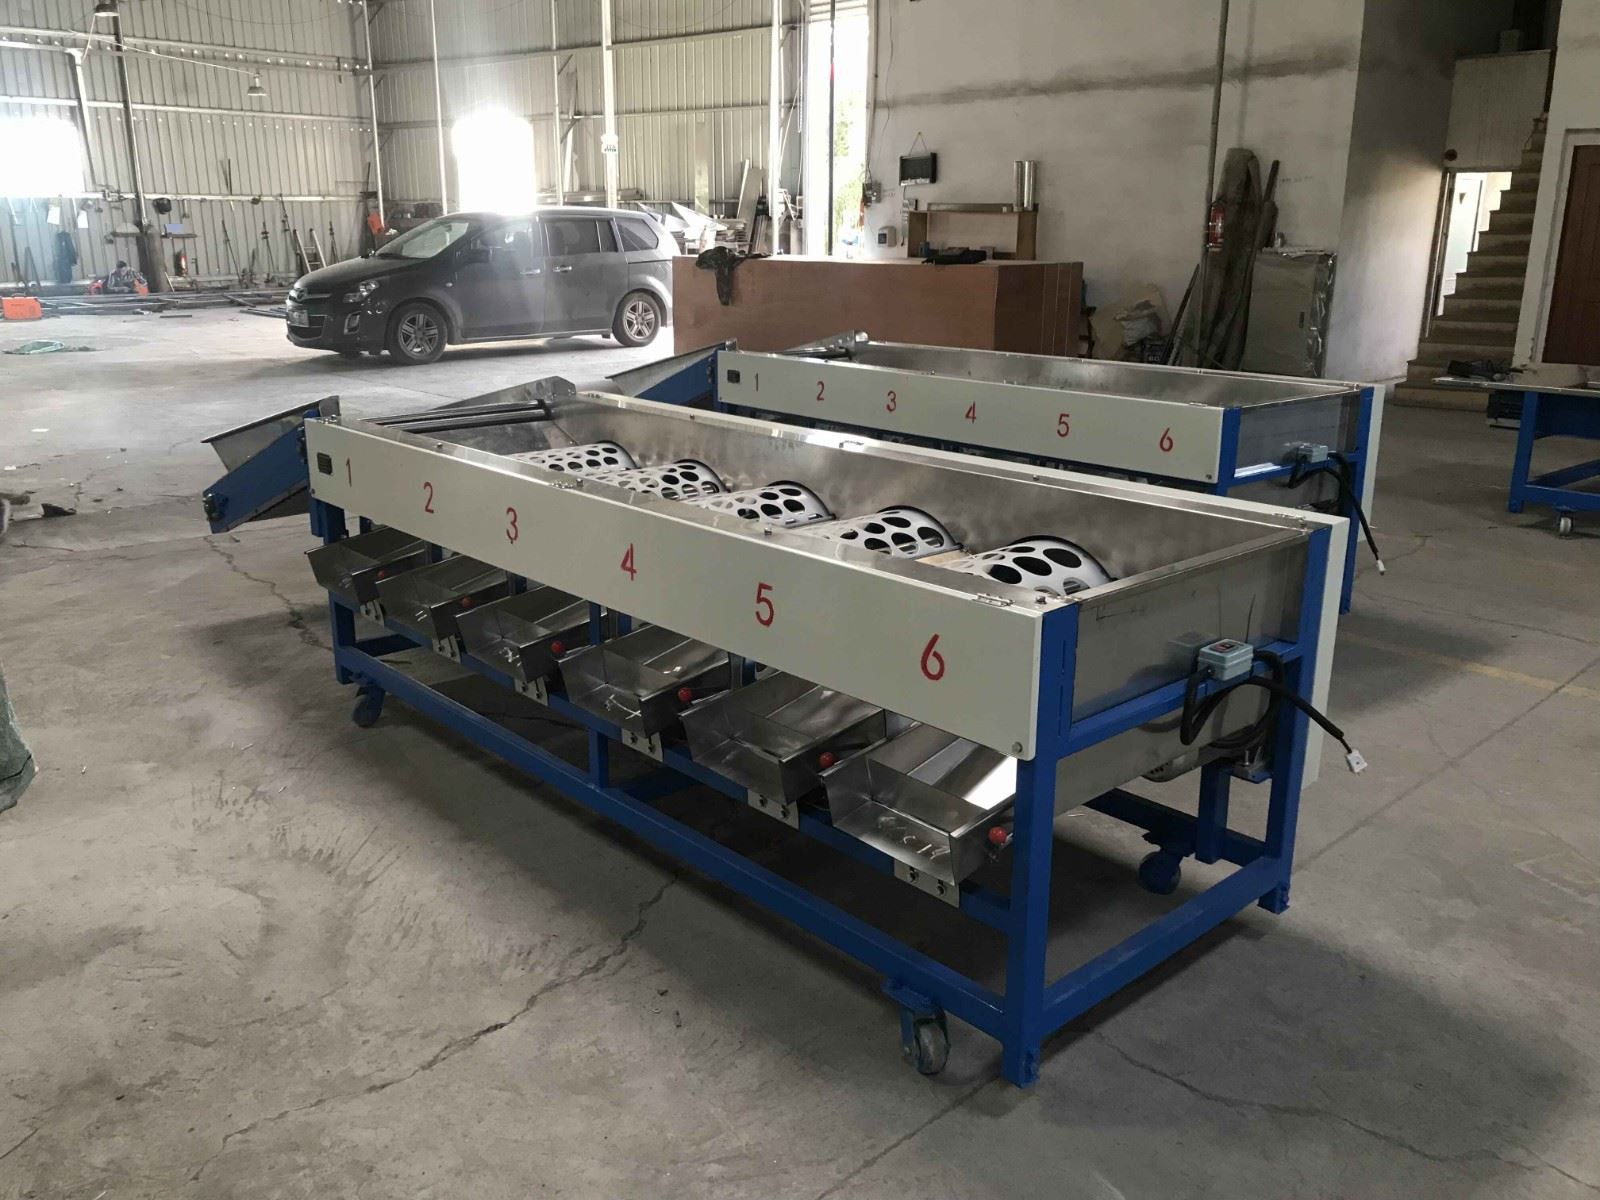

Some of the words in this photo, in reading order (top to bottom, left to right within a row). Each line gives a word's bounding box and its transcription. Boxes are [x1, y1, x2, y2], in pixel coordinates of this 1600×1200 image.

[816, 380, 825, 402] 2
[886, 391, 897, 413] 3
[964, 401, 977, 425] 4
[1057, 413, 1070, 438] 5
[1159, 427, 1174, 453] 6
[345, 458, 352, 488] 1
[423, 481, 434, 514] 2
[506, 507, 518, 545] 3
[620, 543, 638, 582] 4
[755, 582, 775, 628] 5
[920, 634, 945, 681] 6
